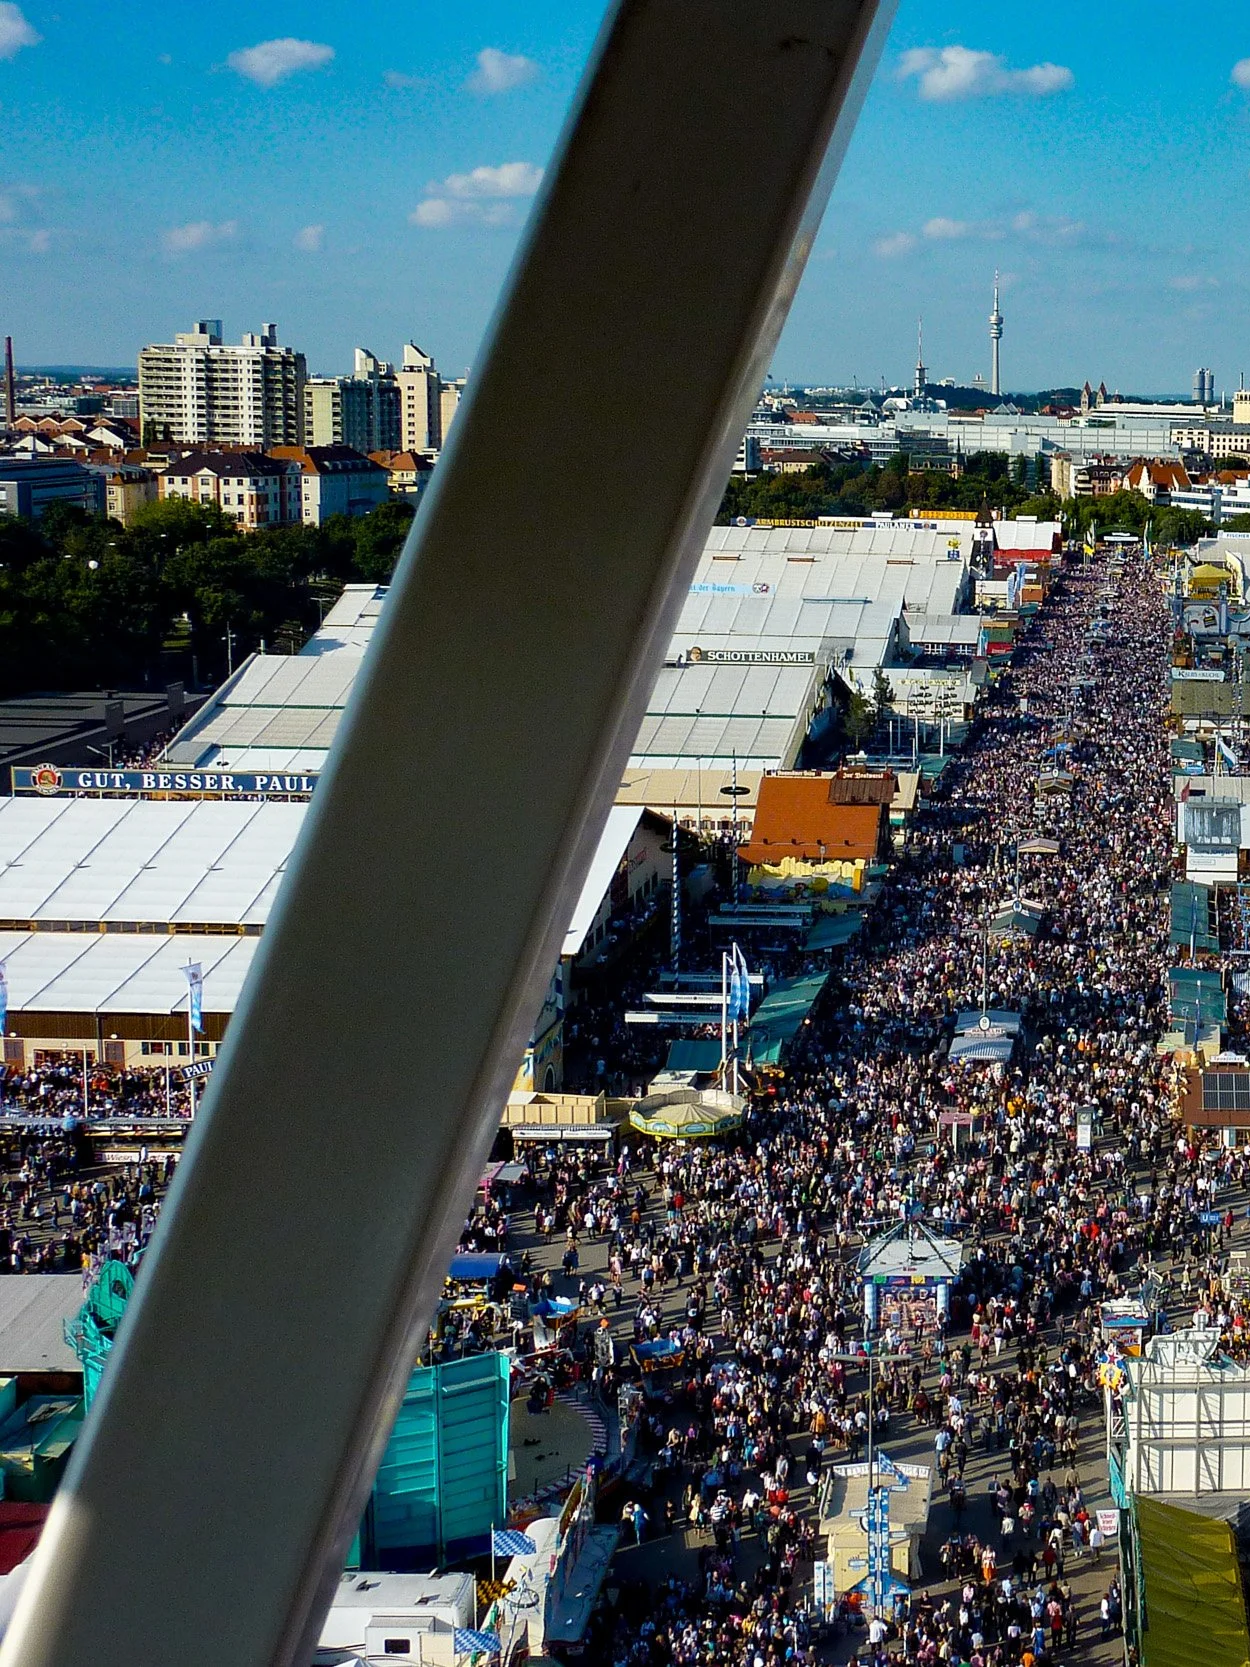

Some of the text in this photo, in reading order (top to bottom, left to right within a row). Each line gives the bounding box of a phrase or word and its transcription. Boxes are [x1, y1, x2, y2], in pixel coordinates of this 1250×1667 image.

[707, 651, 812, 663] SCHOTTENHAMEL
[78, 772, 131, 790] GUT,
[142, 773, 243, 792] BESSER,
